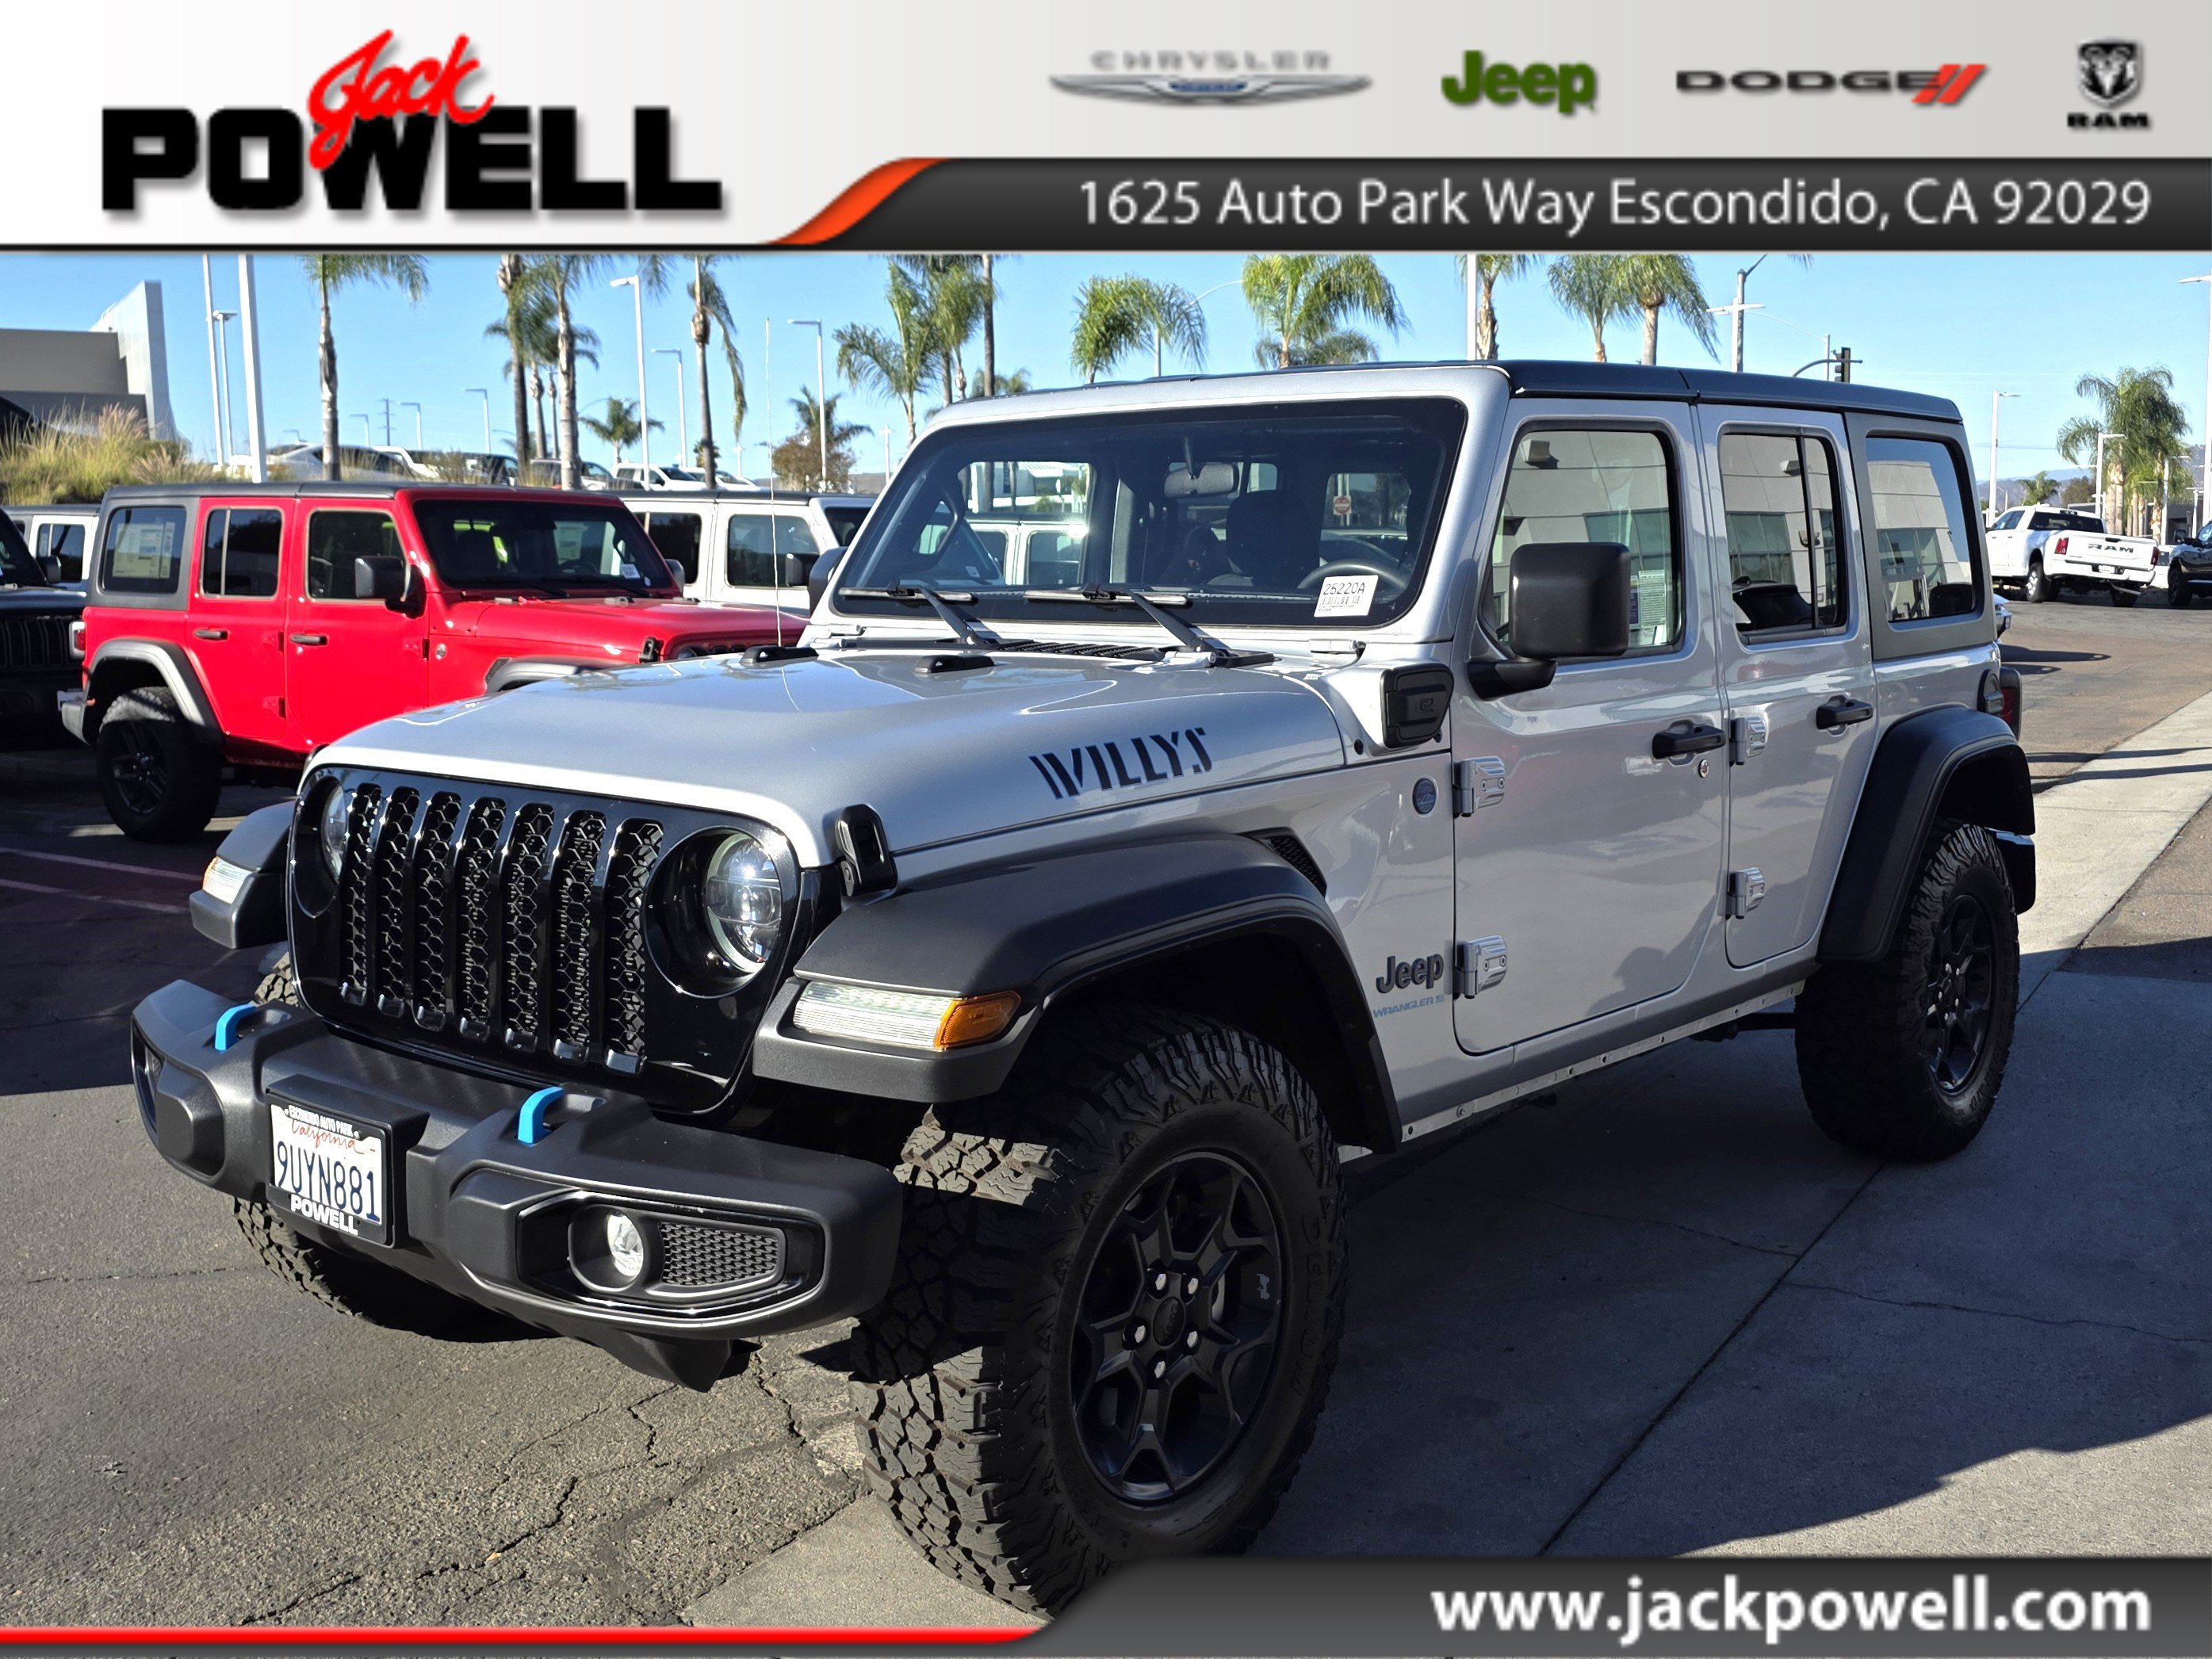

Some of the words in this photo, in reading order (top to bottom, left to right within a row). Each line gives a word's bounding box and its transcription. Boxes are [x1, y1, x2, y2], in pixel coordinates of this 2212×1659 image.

[2088, 543, 2134, 553] RAM
[1322, 582, 1365, 595] 25220A
[1028, 727, 1213, 800] WILLYS
[1376, 954, 1445, 994] Jeep
[1372, 996, 1434, 1019] WRANGLER
[291, 1119, 365, 1155] California
[277, 1140, 381, 1222] 9UYN881
[290, 1193, 358, 1236] POWELL
